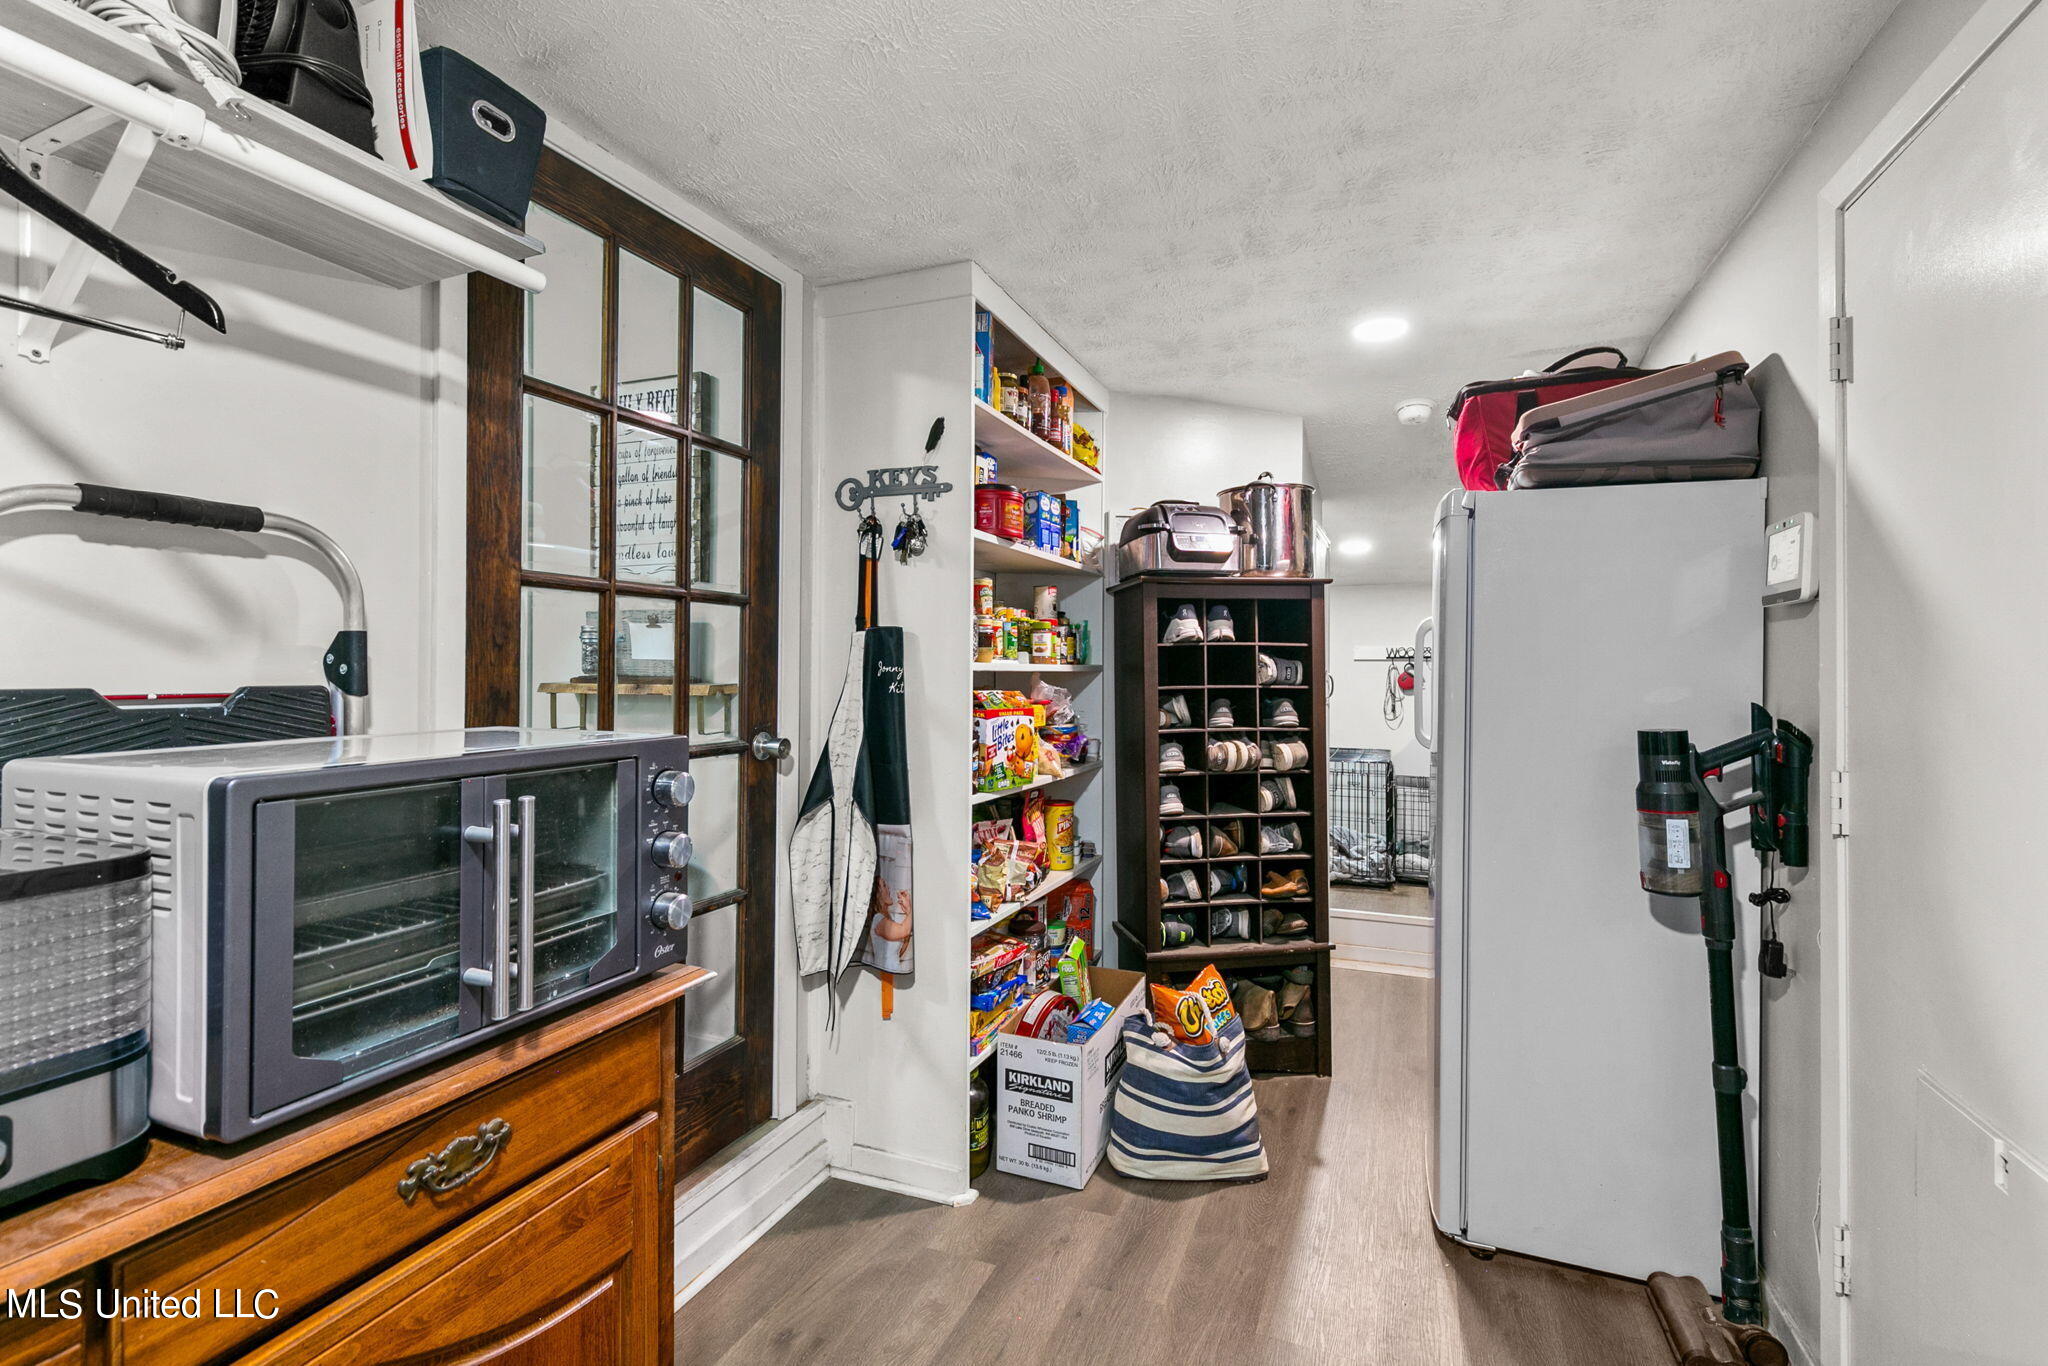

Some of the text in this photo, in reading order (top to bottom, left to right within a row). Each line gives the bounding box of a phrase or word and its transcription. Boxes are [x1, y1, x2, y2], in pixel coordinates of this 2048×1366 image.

[395, 27, 406, 130] essential accessories
[617, 466, 639, 489] gallon
[641, 463, 650, 482] of
[867, 465, 938, 489] KEYS
[623, 489, 643, 513] pinch
[645, 488, 653, 511] of
[655, 488, 673, 510] hope
[616, 513, 645, 538] poonful
[648, 513, 656, 536] of
[617, 545, 651, 561] ndless
[1385, 646, 1415, 659] WOO
[992, 718, 1010, 743] Little
[997, 730, 1015, 751] Bites
[654, 942, 676, 959] Oster
[1000, 1041, 1014, 1050] ITEM
[1000, 1048, 1023, 1059] 21466
[1058, 1059, 1079, 1068] FROZEN
[1008, 1071, 1071, 1093] KIRKLAND
[1008, 1082, 1070, 1100] Signature
[1008, 1104, 1068, 1124] PANKO SHRIMP
[1020, 1098, 1056, 1113] BREADED
